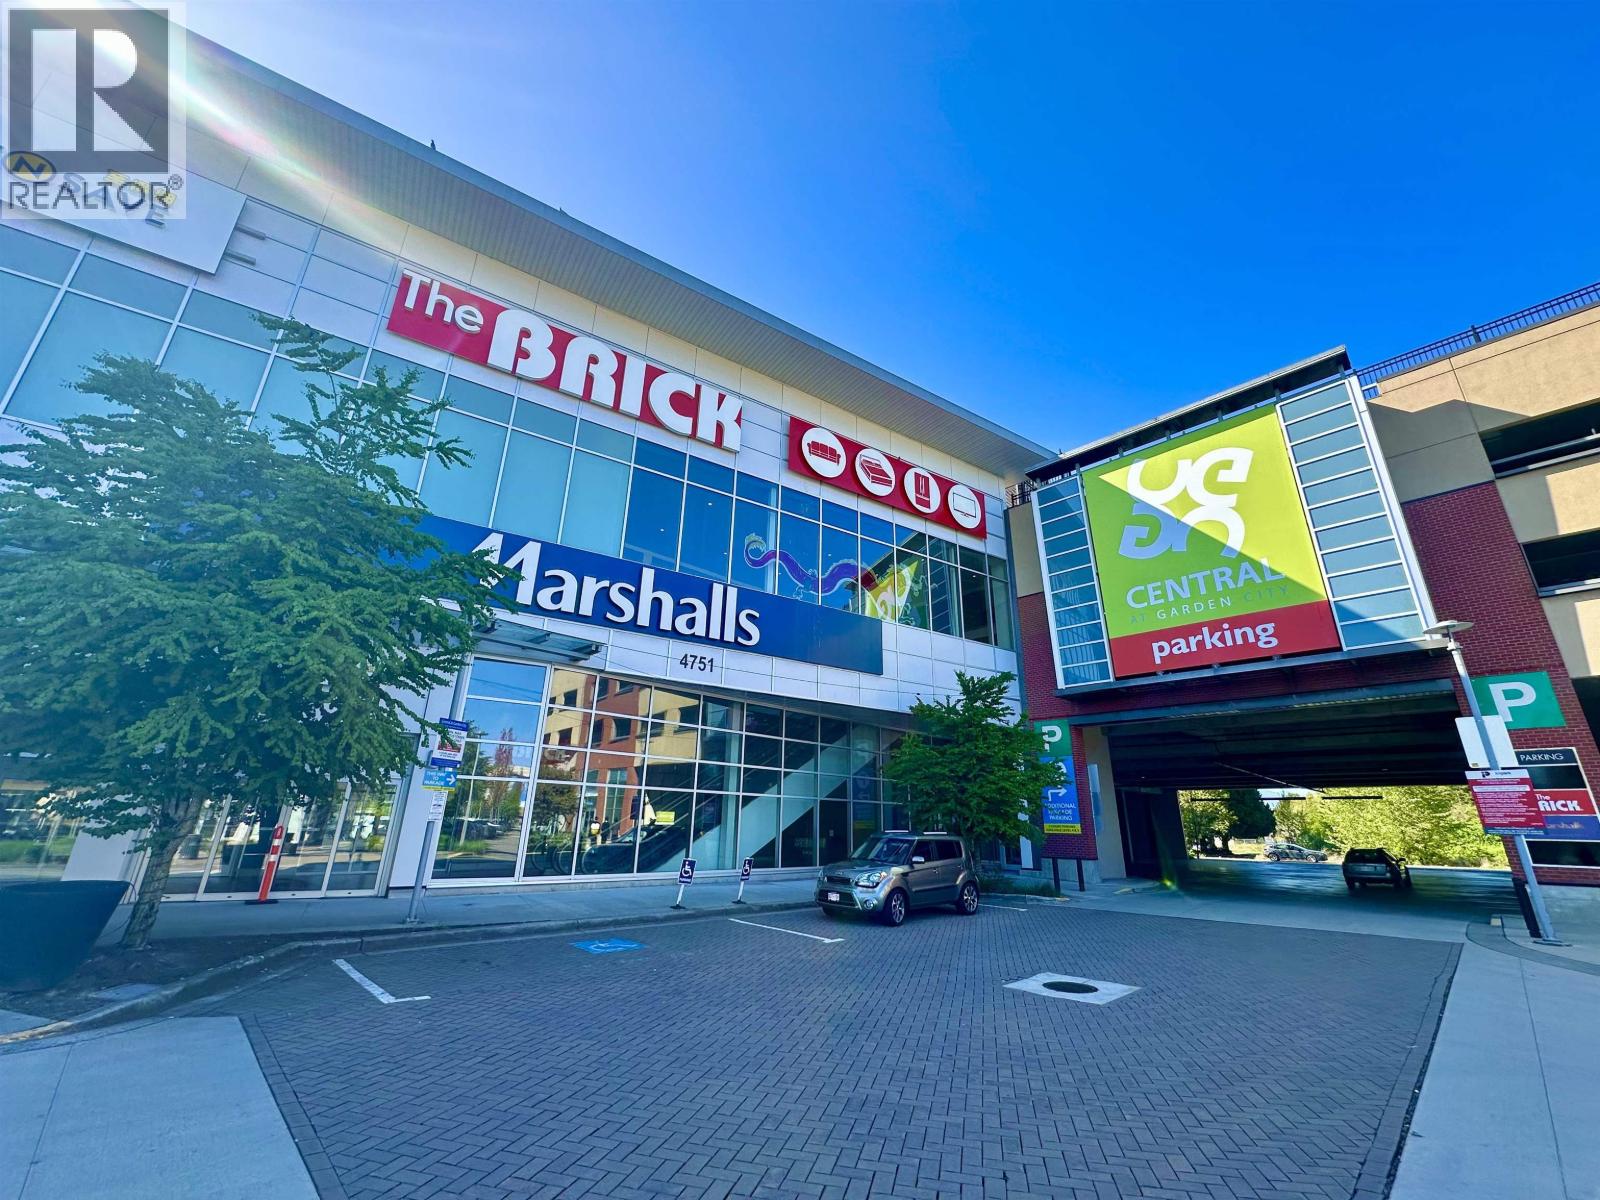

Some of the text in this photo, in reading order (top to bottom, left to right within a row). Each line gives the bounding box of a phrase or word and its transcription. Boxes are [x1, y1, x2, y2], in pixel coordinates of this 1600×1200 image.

[402, 268, 484, 335] The
[487, 309, 743, 453] BRICK
[471, 532, 761, 647] Marshalls
[1126, 557, 1286, 609] CENTRAL
[1130, 584, 1290, 624] AT GARDEN CITY
[679, 653, 715, 673] 4751
[1151, 622, 1280, 664] parking
[1488, 681, 1537, 723] P
[1041, 725, 1063, 752] P
[1519, 752, 1565, 762] PARKING
[1535, 793, 1551, 801] The
[1537, 800, 1582, 812] RICK
